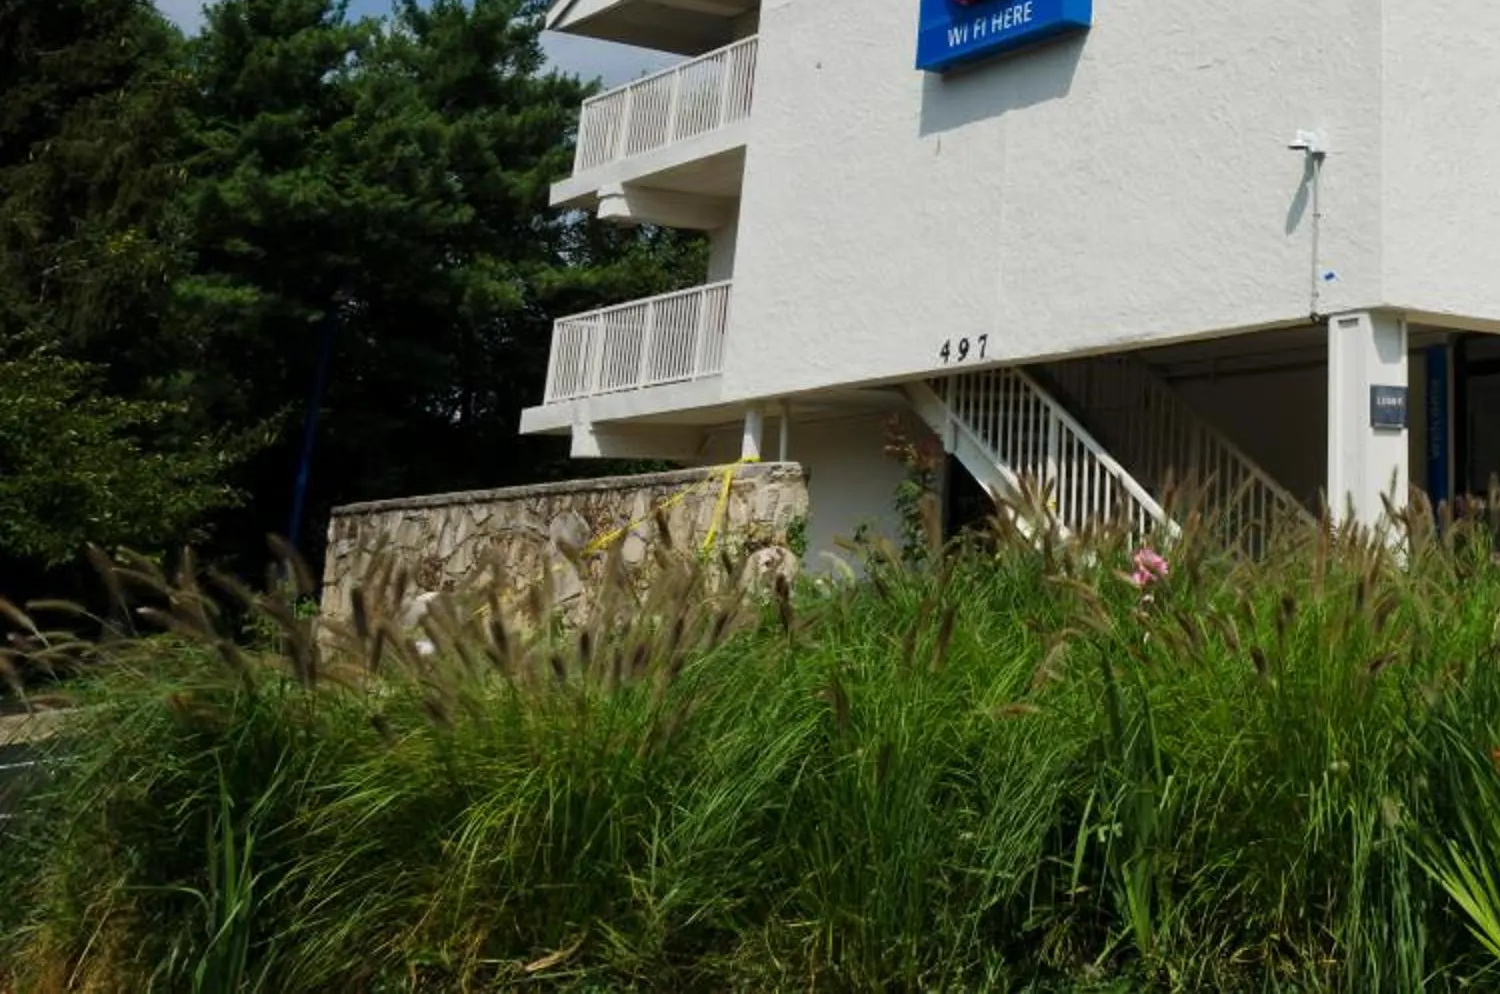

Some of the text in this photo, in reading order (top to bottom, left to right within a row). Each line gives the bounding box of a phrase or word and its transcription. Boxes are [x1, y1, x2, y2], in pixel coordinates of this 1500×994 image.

[947, 1, 1032, 47] WI FI HERE
[940, 333, 988, 364] 497
